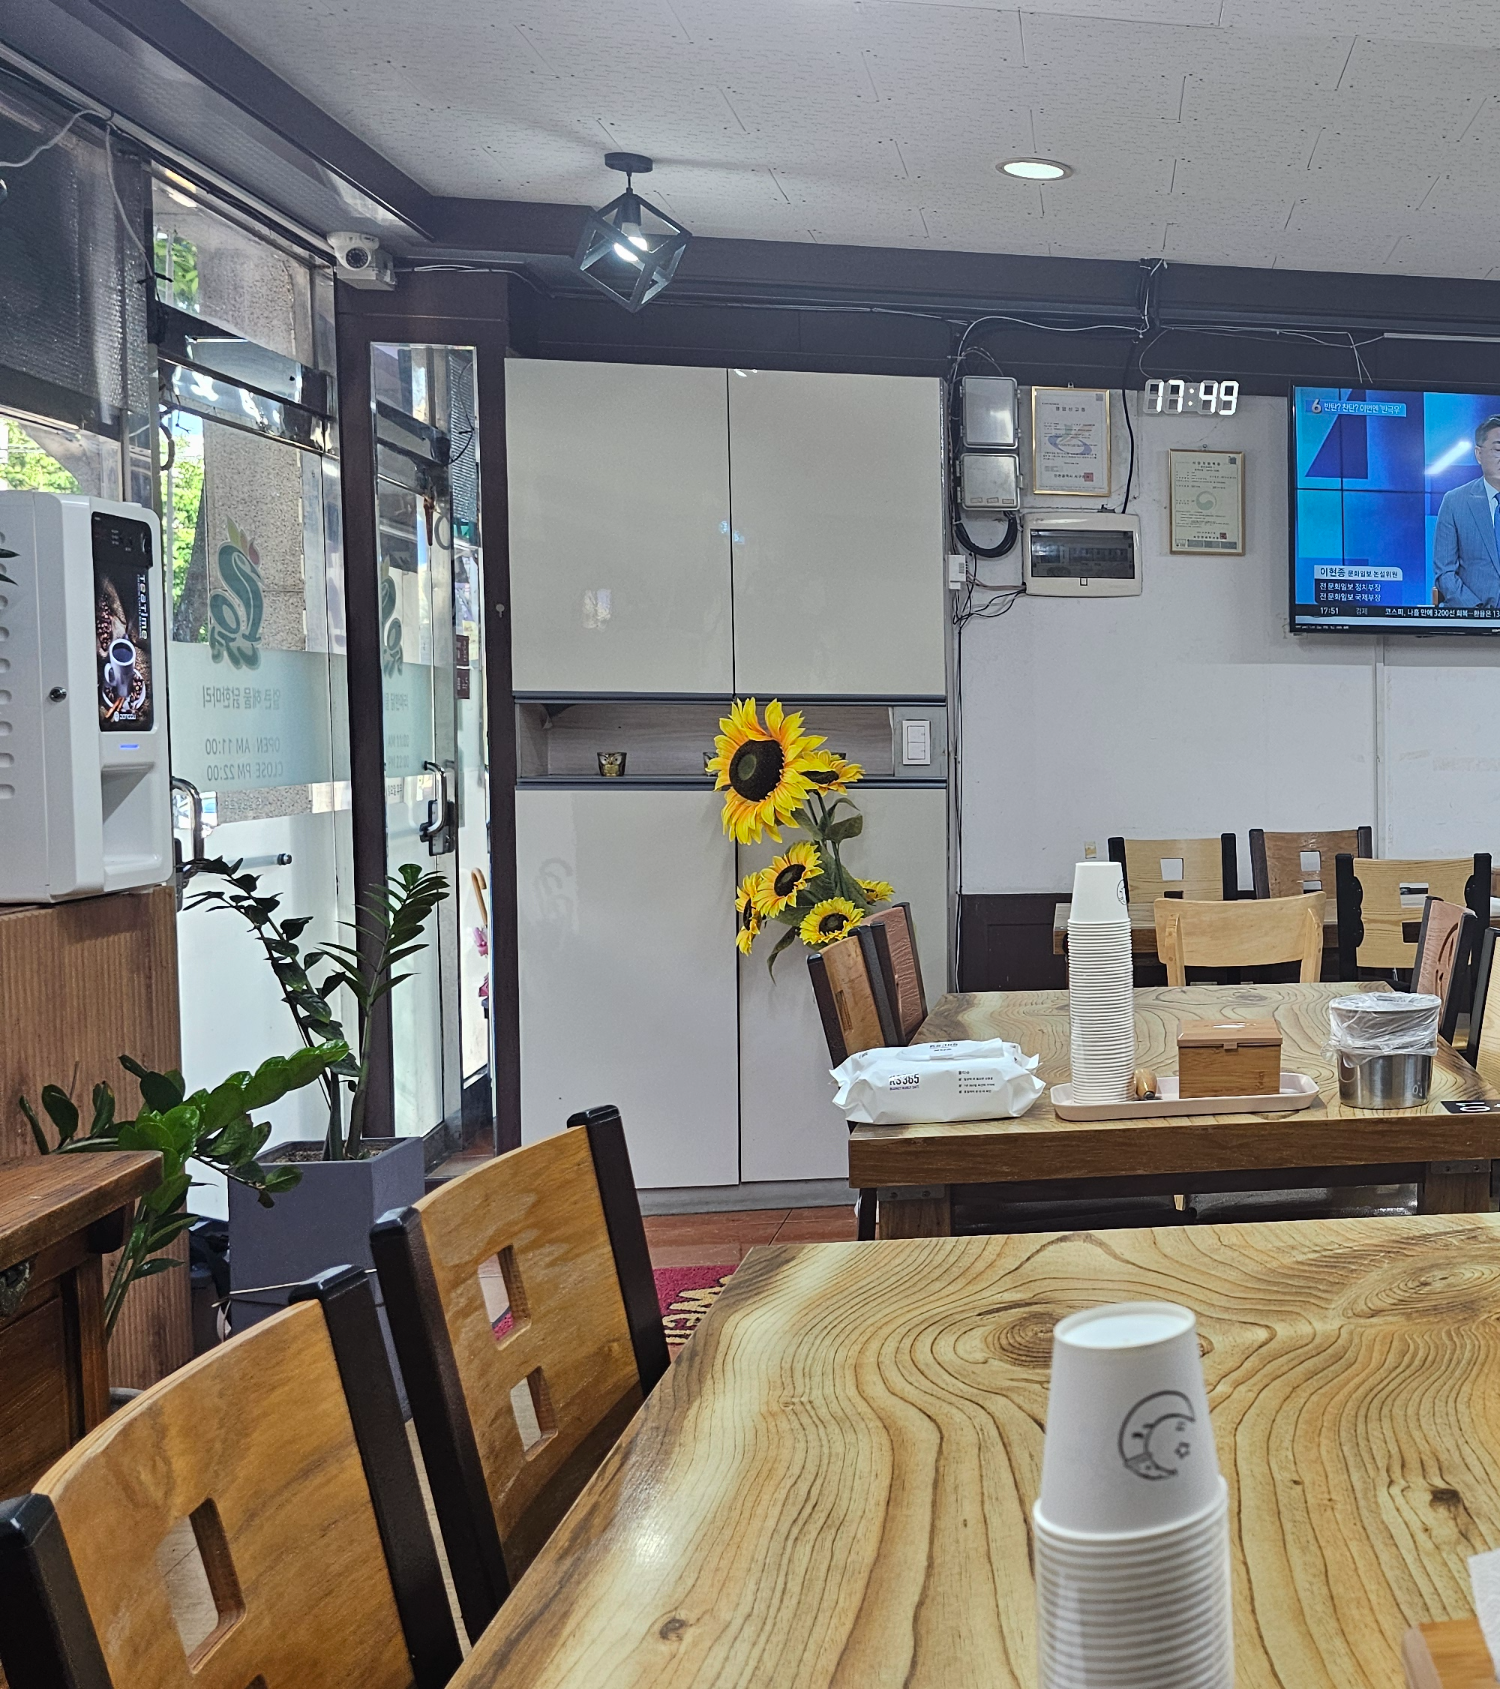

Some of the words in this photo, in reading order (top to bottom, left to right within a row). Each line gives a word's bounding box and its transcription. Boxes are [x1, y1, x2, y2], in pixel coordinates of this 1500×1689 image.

[1157, 379, 1239, 416] 17:49
[1312, 398, 1322, 414] 6
[1320, 607, 1339, 615] 17:51
